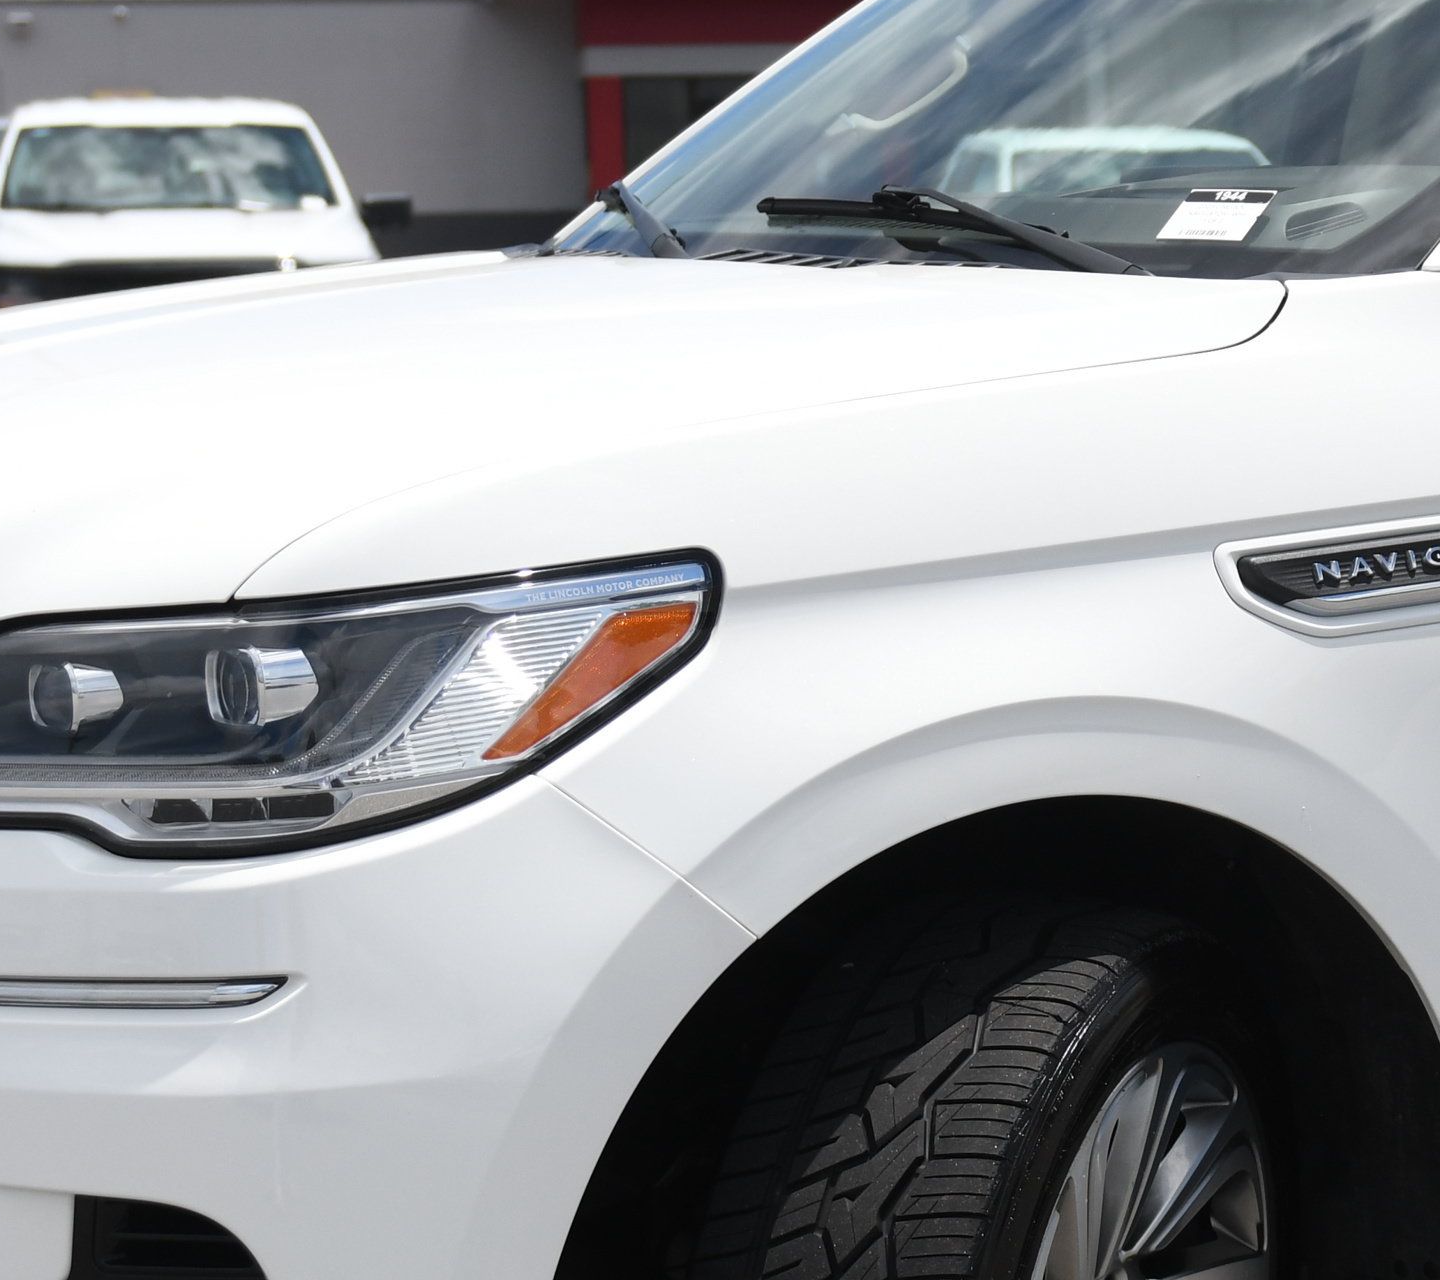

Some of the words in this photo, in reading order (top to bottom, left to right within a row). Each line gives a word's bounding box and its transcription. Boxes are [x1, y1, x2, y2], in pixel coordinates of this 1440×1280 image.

[1214, 191, 1249, 201] 1944
[525, 591, 547, 602] THE
[548, 587, 595, 600] LINCOLN
[596, 580, 633, 593] MOTOR
[635, 573, 685, 587] COMPANY
